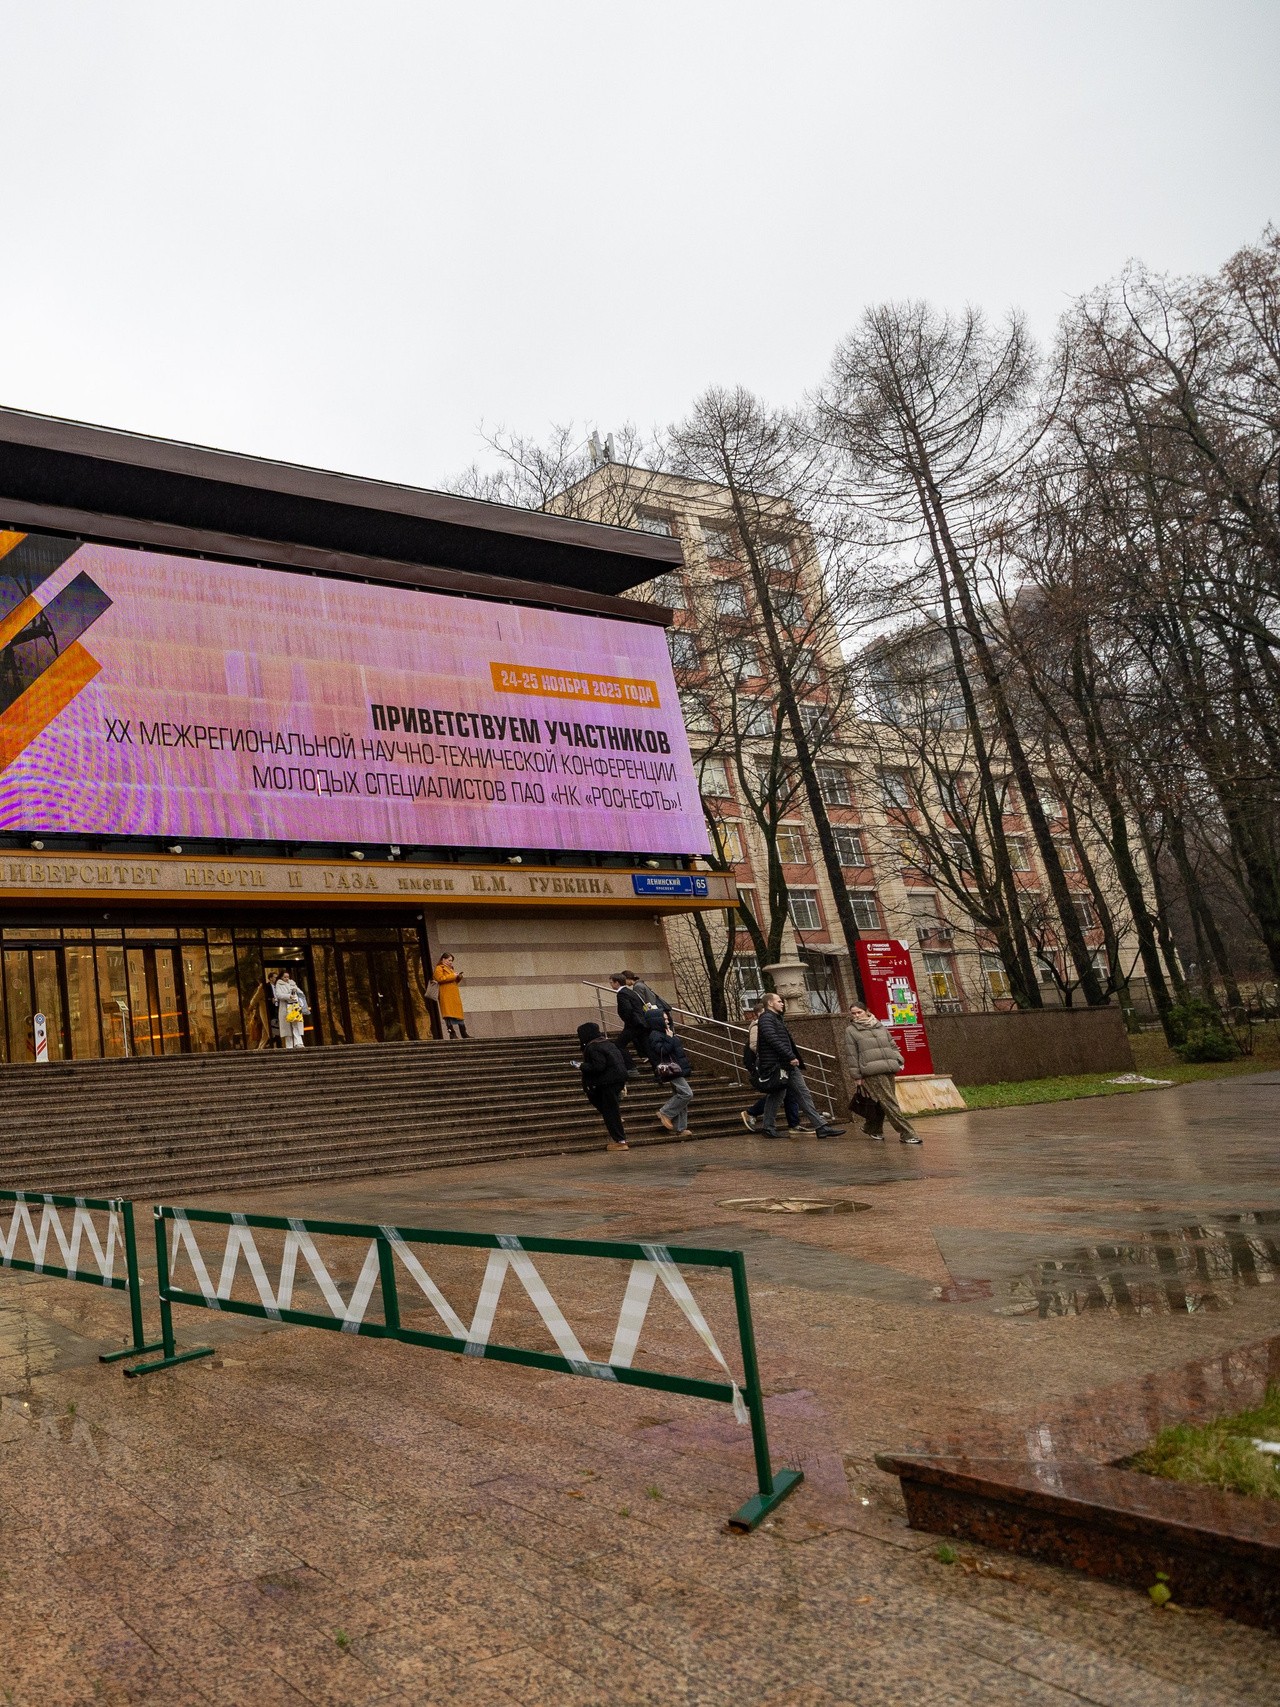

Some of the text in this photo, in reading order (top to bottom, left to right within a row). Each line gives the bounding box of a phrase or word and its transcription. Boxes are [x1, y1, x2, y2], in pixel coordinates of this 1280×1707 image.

[501, 670, 654, 704] 24-25 НОЯБРЯ 2025 ГОДА
[371, 704, 671, 754] ПРИВЕТСТВУЕМ УЧАСТНИКОВ
[104, 718, 678, 785] XX МЕЖРЕГИОНАЛЬНОЙ НАУЧНО-ТЕХНИЧЕСКОЙ КОНФЕРЕНЦИИ
[252, 765, 683, 811] МОЛОДЫХ СПЕЦИАЛИСТОВ ПАО «НК «РОСНЕФТЬ»!
[184, 867, 266, 887] НЕФТИ
[287, 870, 303, 888] И
[323, 871, 379, 889] ГАЗА
[397, 878, 454, 891] имени
[472, 875, 512, 892] И.М.
[528, 876, 613, 894] ГУБКИНА
[646, 878, 681, 886] ЛЕНИНСКИЙ
[695, 879, 706, 889] 65
